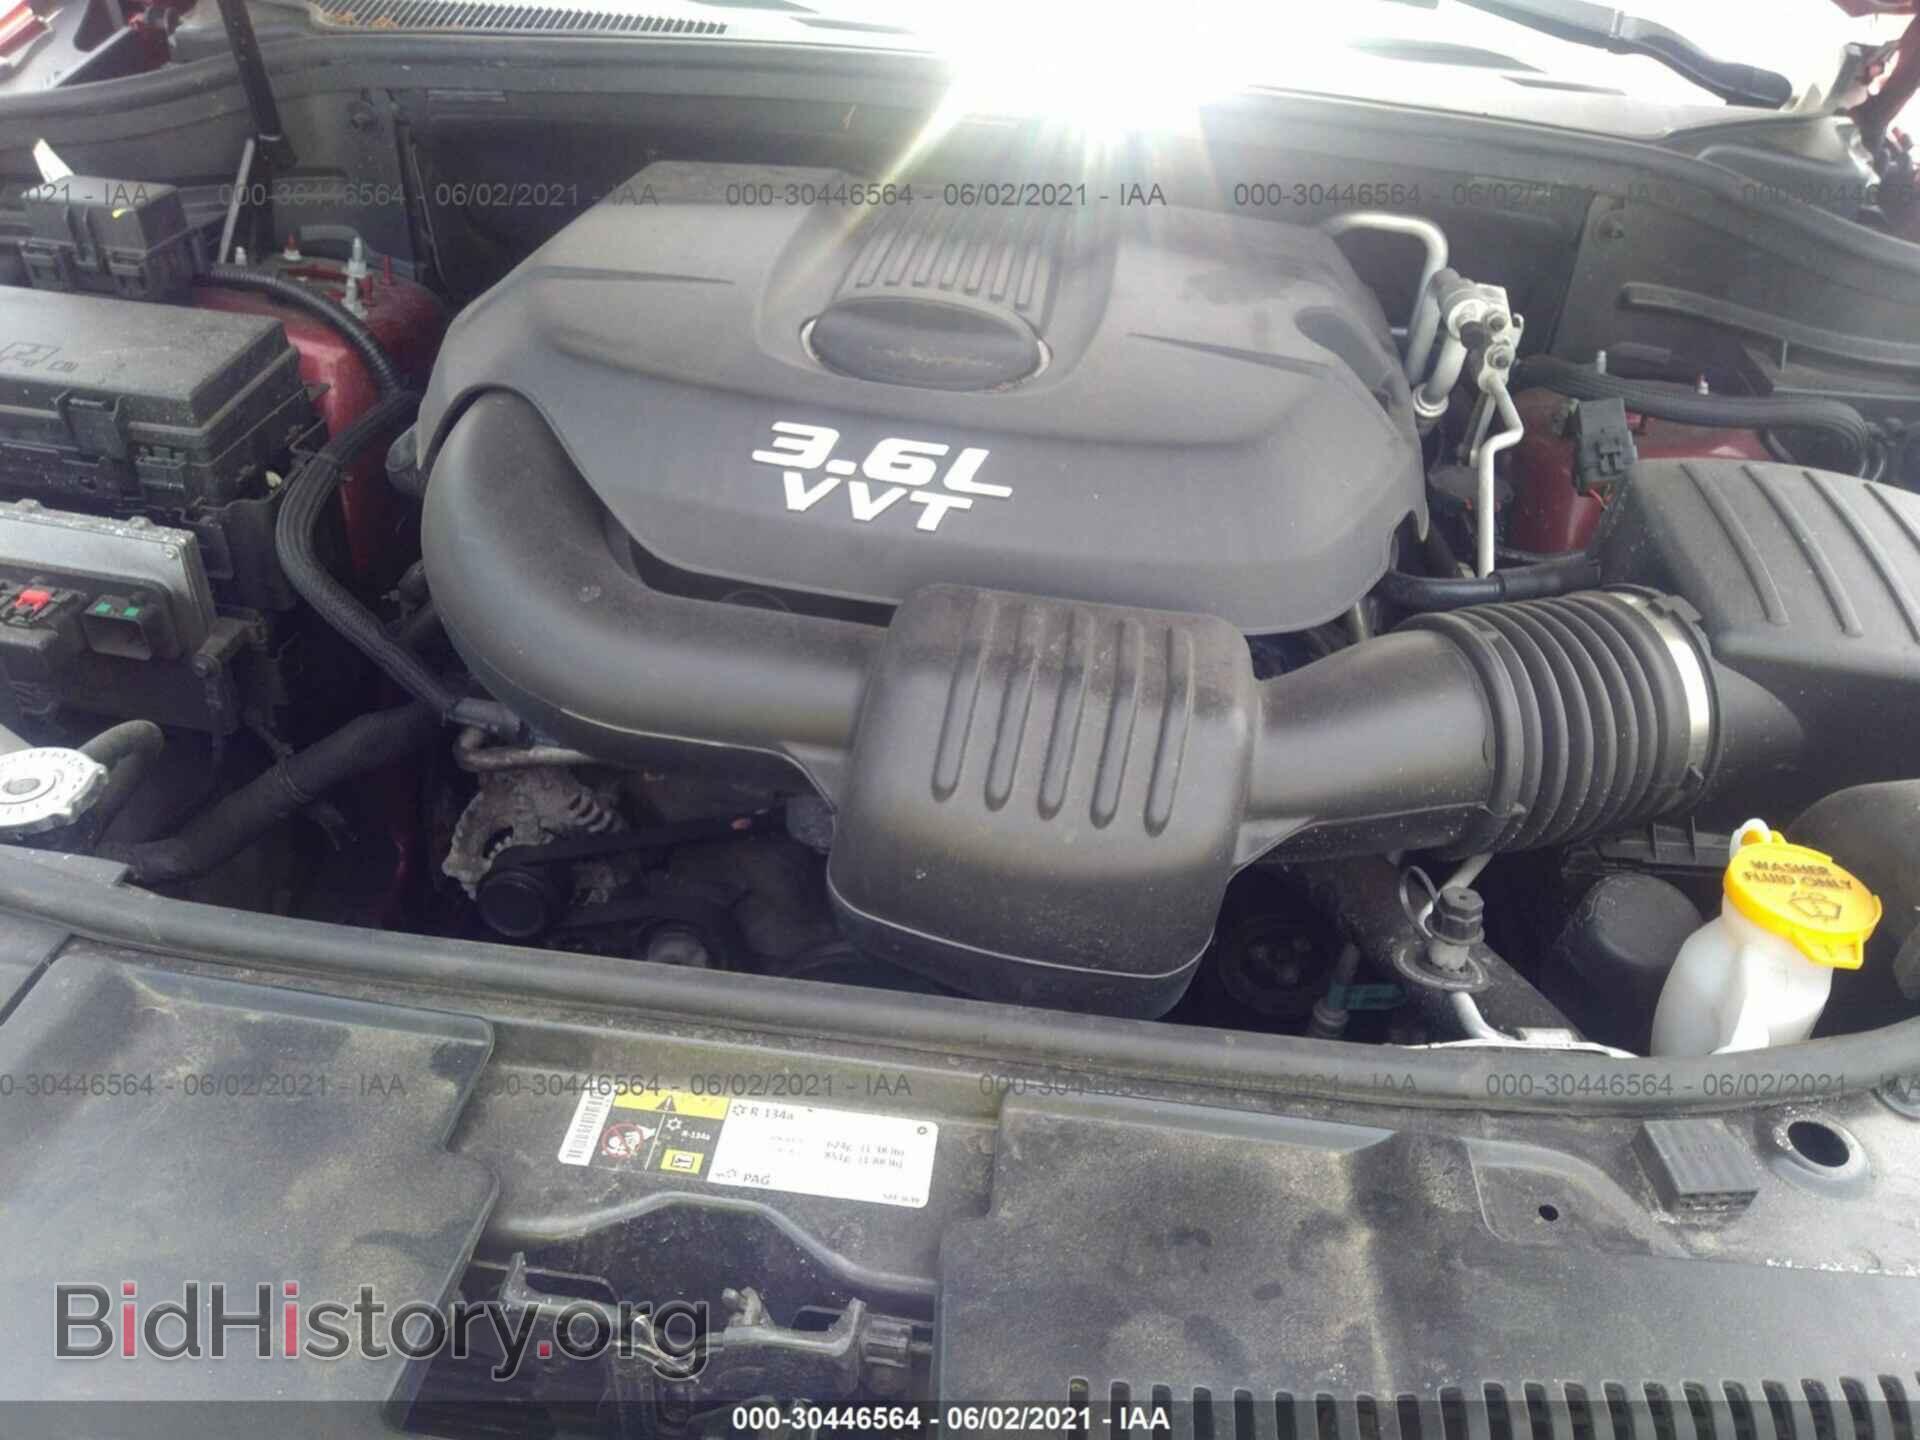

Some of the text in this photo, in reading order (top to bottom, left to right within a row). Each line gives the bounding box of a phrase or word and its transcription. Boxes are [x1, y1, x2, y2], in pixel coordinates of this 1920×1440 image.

[752, 421, 1013, 498] 3.6L
[783, 471, 974, 532] VVT
[1743, 871, 1853, 890] FLUID ONLY
[1750, 860, 1831, 876] WASHER
